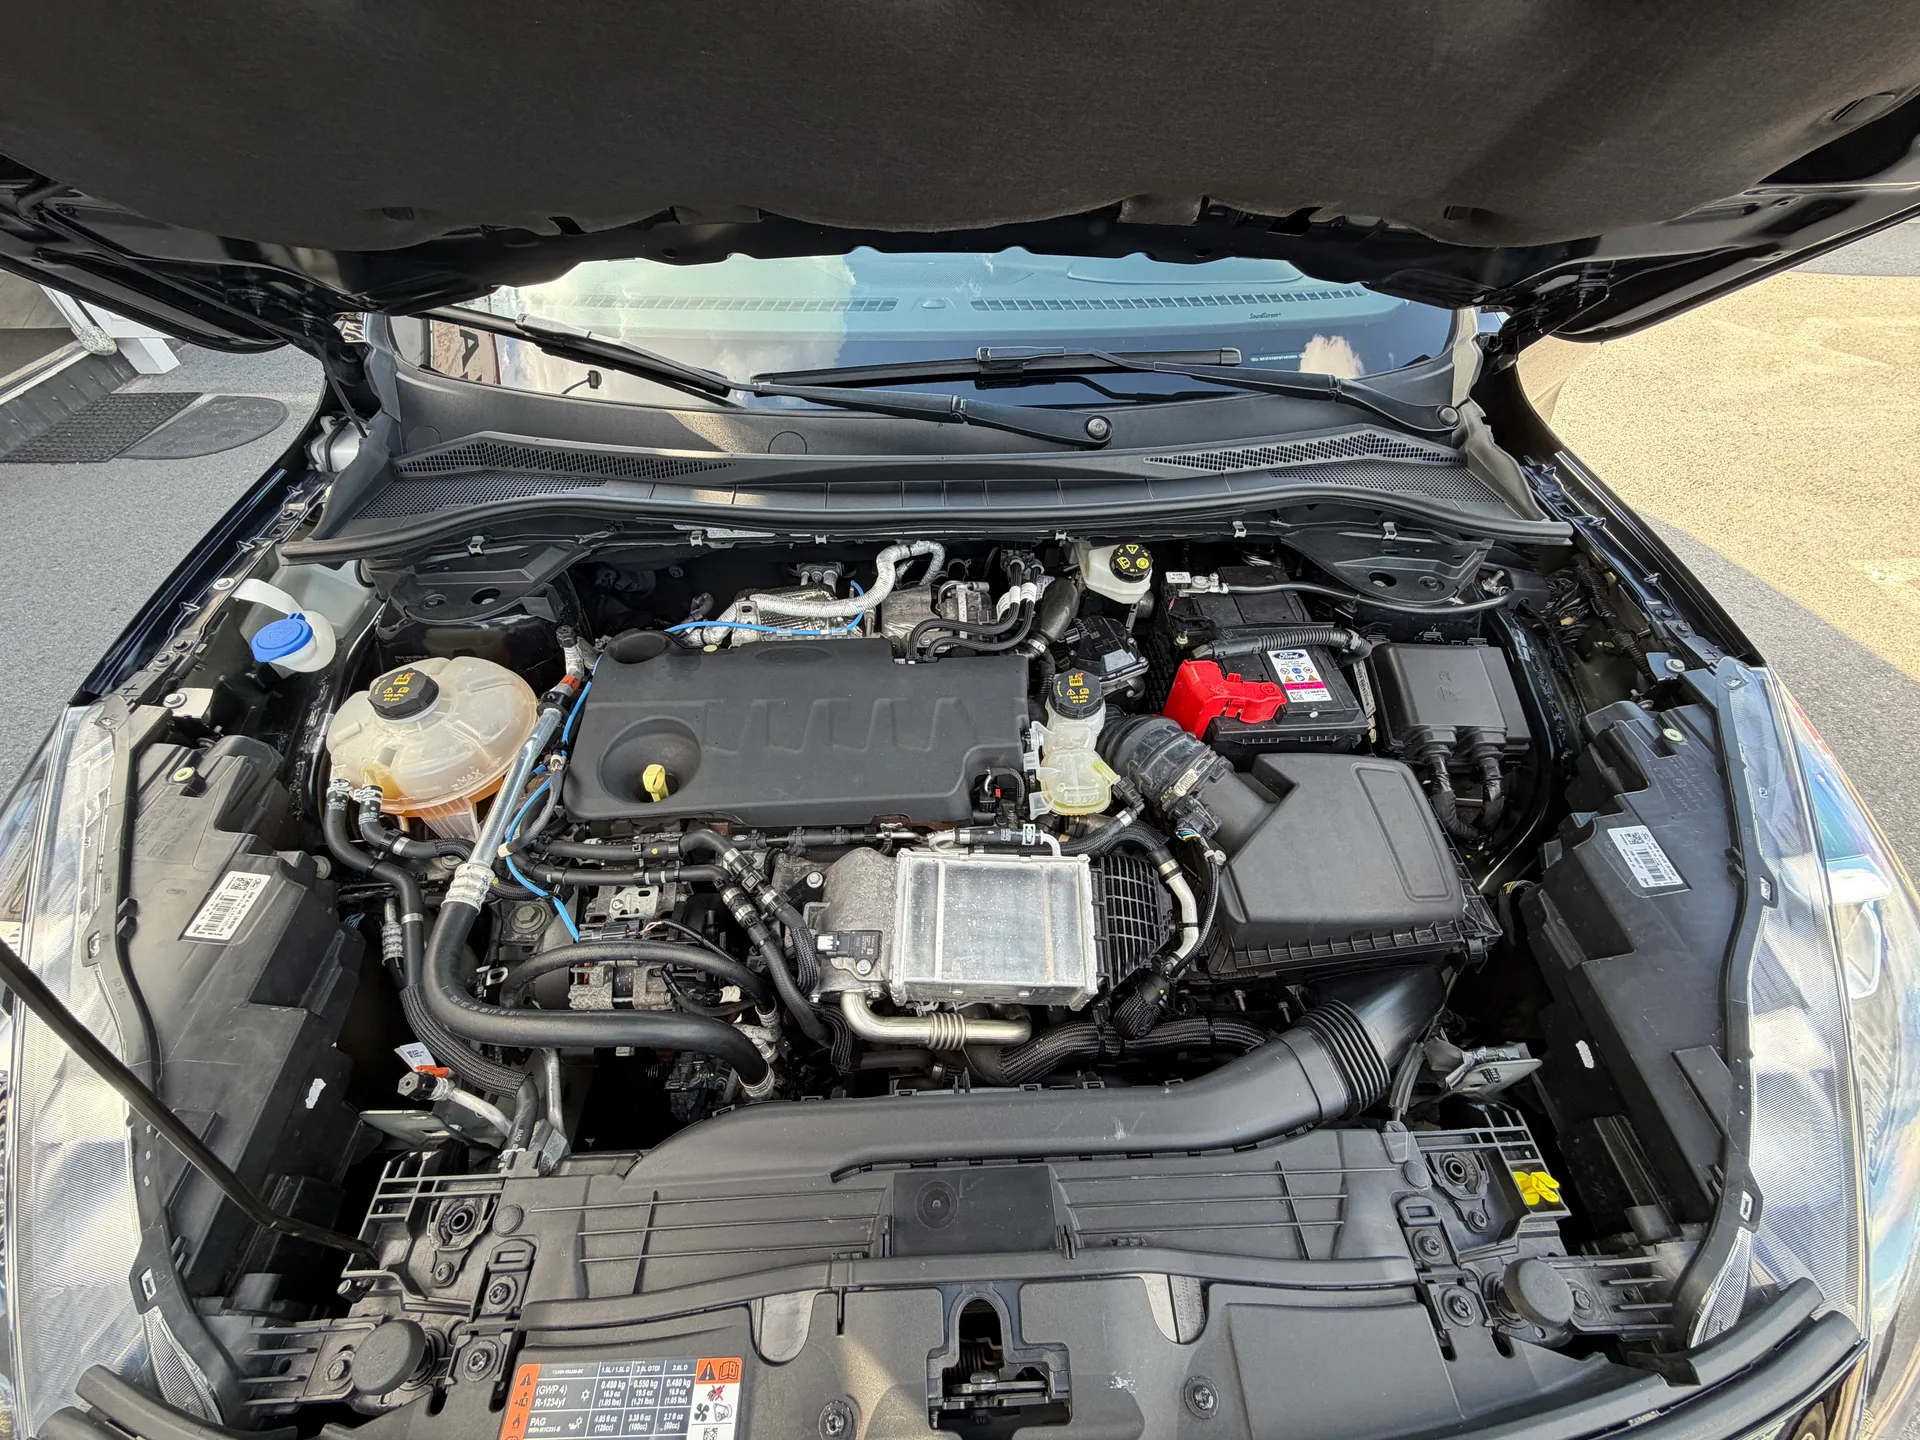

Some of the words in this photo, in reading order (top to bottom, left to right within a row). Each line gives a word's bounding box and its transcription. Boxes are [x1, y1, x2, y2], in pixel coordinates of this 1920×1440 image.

[457, 769, 482, 786] MAX
[601, 1380, 616, 1389] 0.480
[617, 1380, 626, 1390] kg
[633, 1379, 649, 1388] 0.550
[650, 1379, 658, 1389] kg
[666, 1379, 682, 1387] 0.480
[683, 1378, 691, 1388] kg
[536, 1385, 558, 1396] (GWP
[559, 1385, 568, 1395] 4)
[535, 1398, 566, 1408] R-1234yf
[530, 1417, 546, 1426] PAG
